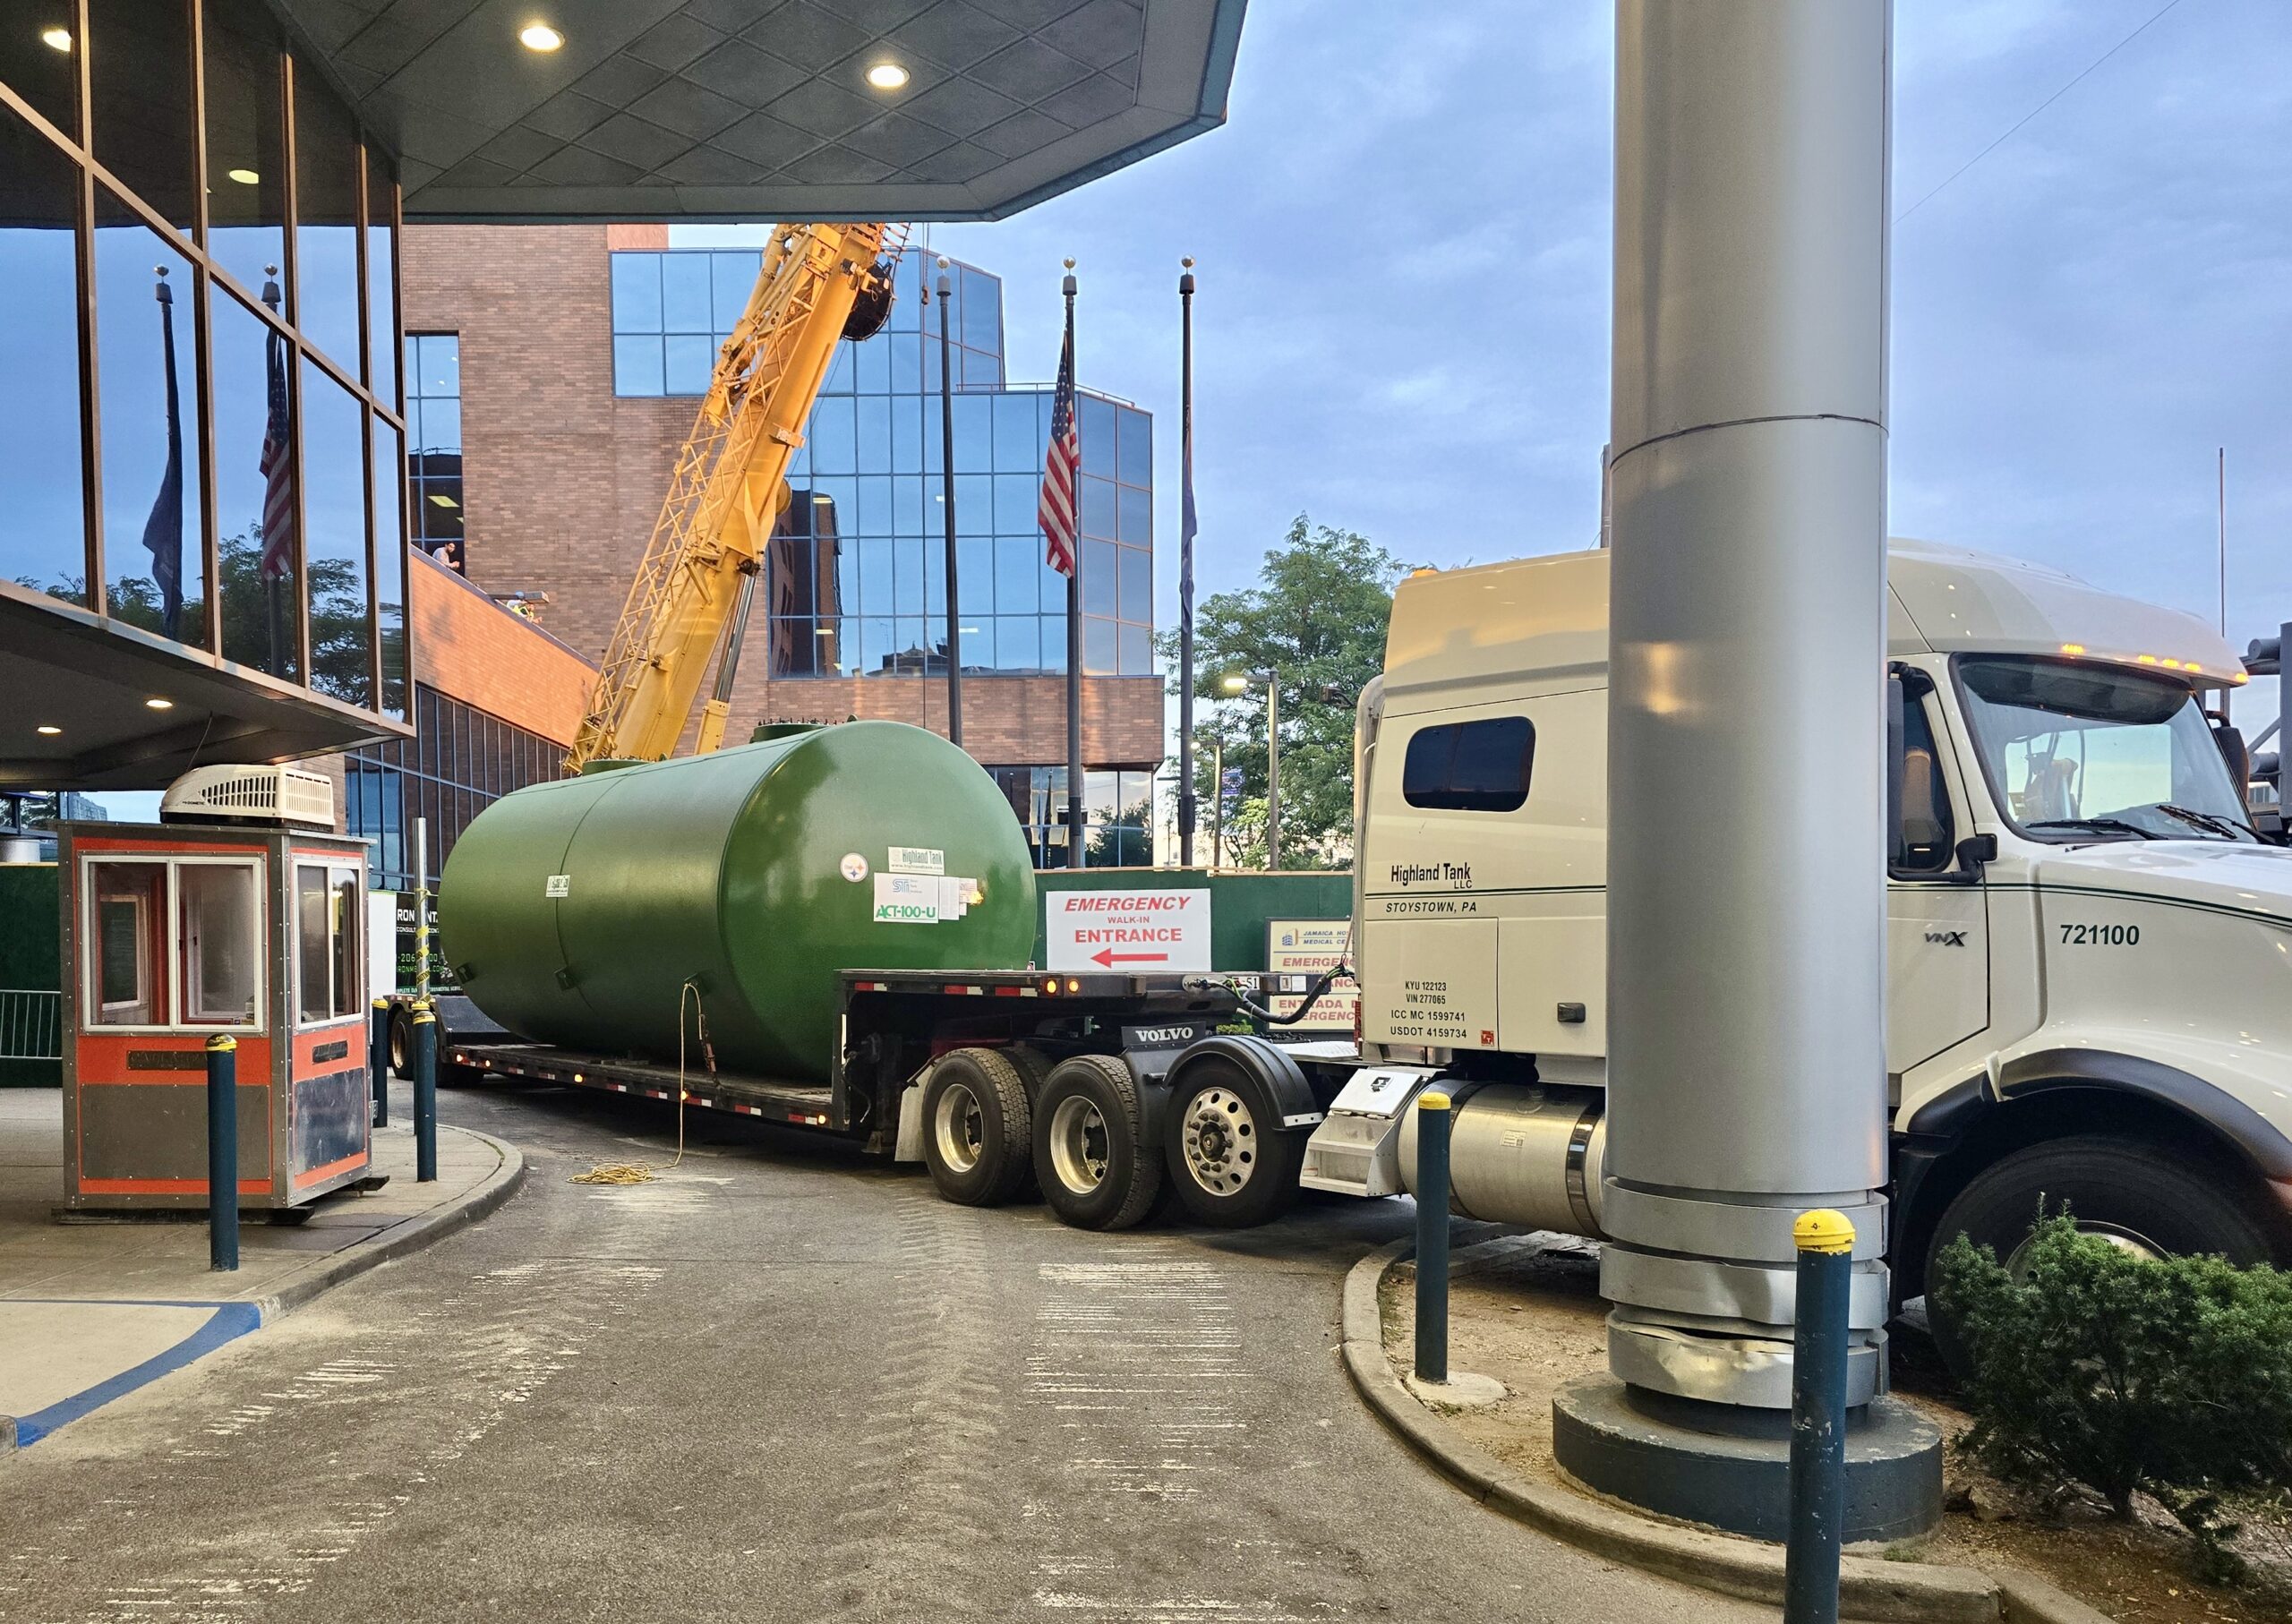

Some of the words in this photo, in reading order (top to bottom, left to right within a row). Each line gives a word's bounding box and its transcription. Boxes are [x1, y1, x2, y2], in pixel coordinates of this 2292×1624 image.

[902, 849, 928, 864] Highland
[929, 850, 943, 865] Tank
[1390, 864, 1440, 886] Highland
[1443, 862, 1471, 880] Tank
[1453, 879, 1473, 889] LLC
[1065, 896, 1192, 911] EMERGENCY
[1386, 902, 1458, 913] STOYSTOWN,
[1461, 902, 1477, 912] PA
[876, 904, 936, 919] ACT-100-U
[1107, 916, 1150, 924] WALK-IN
[1074, 928, 1183, 944] ENTRANCE
[2060, 924, 2140, 945] 721100
[1405, 981, 1421, 990] KYU
[1422, 981, 1447, 991] 122123
[1406, 994, 1418, 1003] VIN
[1419, 994, 1446, 1004] 277065
[1390, 1010, 1407, 1019] ICC
[1410, 1010, 1424, 1020] MC
[1427, 1011, 1466, 1021] 1599741
[1135, 1027, 1193, 1042] VOLVO
[1390, 1026, 1424, 1037] USDOT
[1426, 1027, 1467, 1039] 4159734
